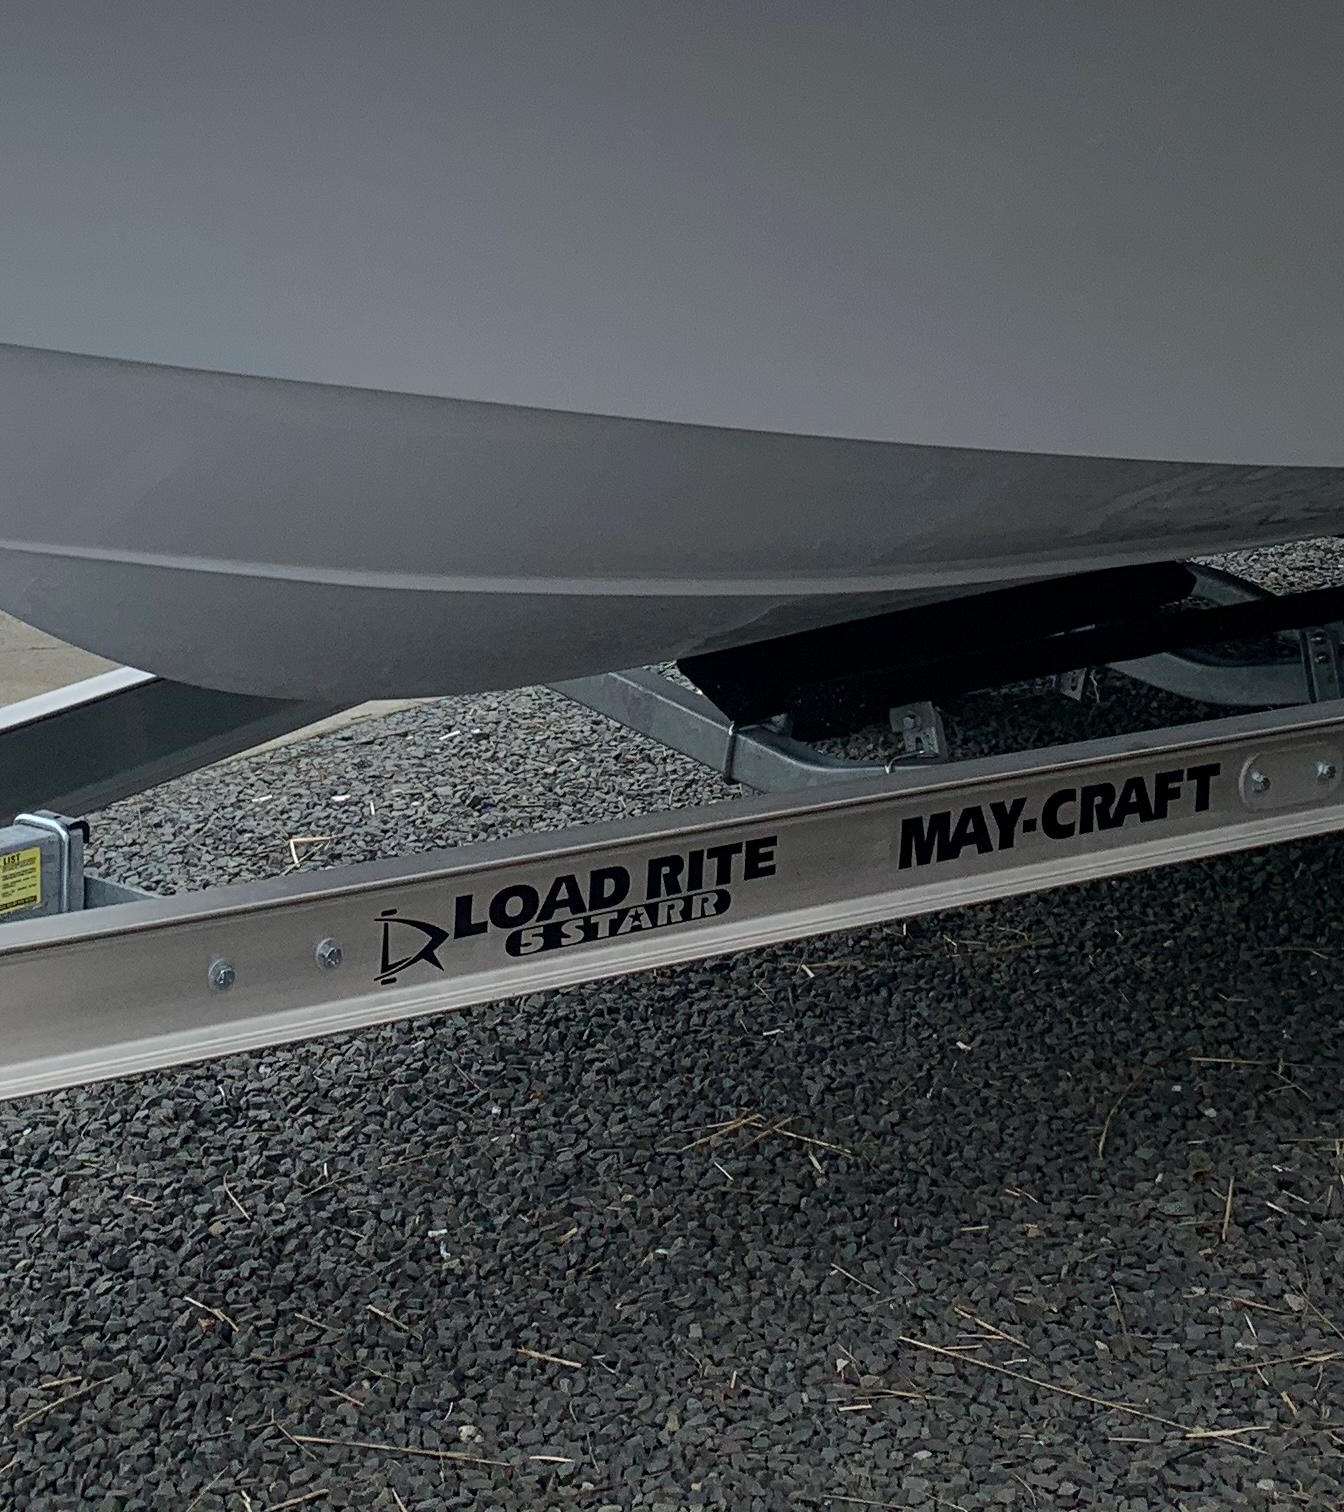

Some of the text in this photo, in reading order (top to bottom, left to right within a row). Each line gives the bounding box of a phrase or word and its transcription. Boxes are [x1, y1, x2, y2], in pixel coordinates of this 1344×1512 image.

[898, 763, 1221, 870] MAY-CRAFT
[3, 853, 21, 867] LIST
[454, 835, 778, 939] LOAD RITE
[519, 888, 720, 955] 5 STARR
